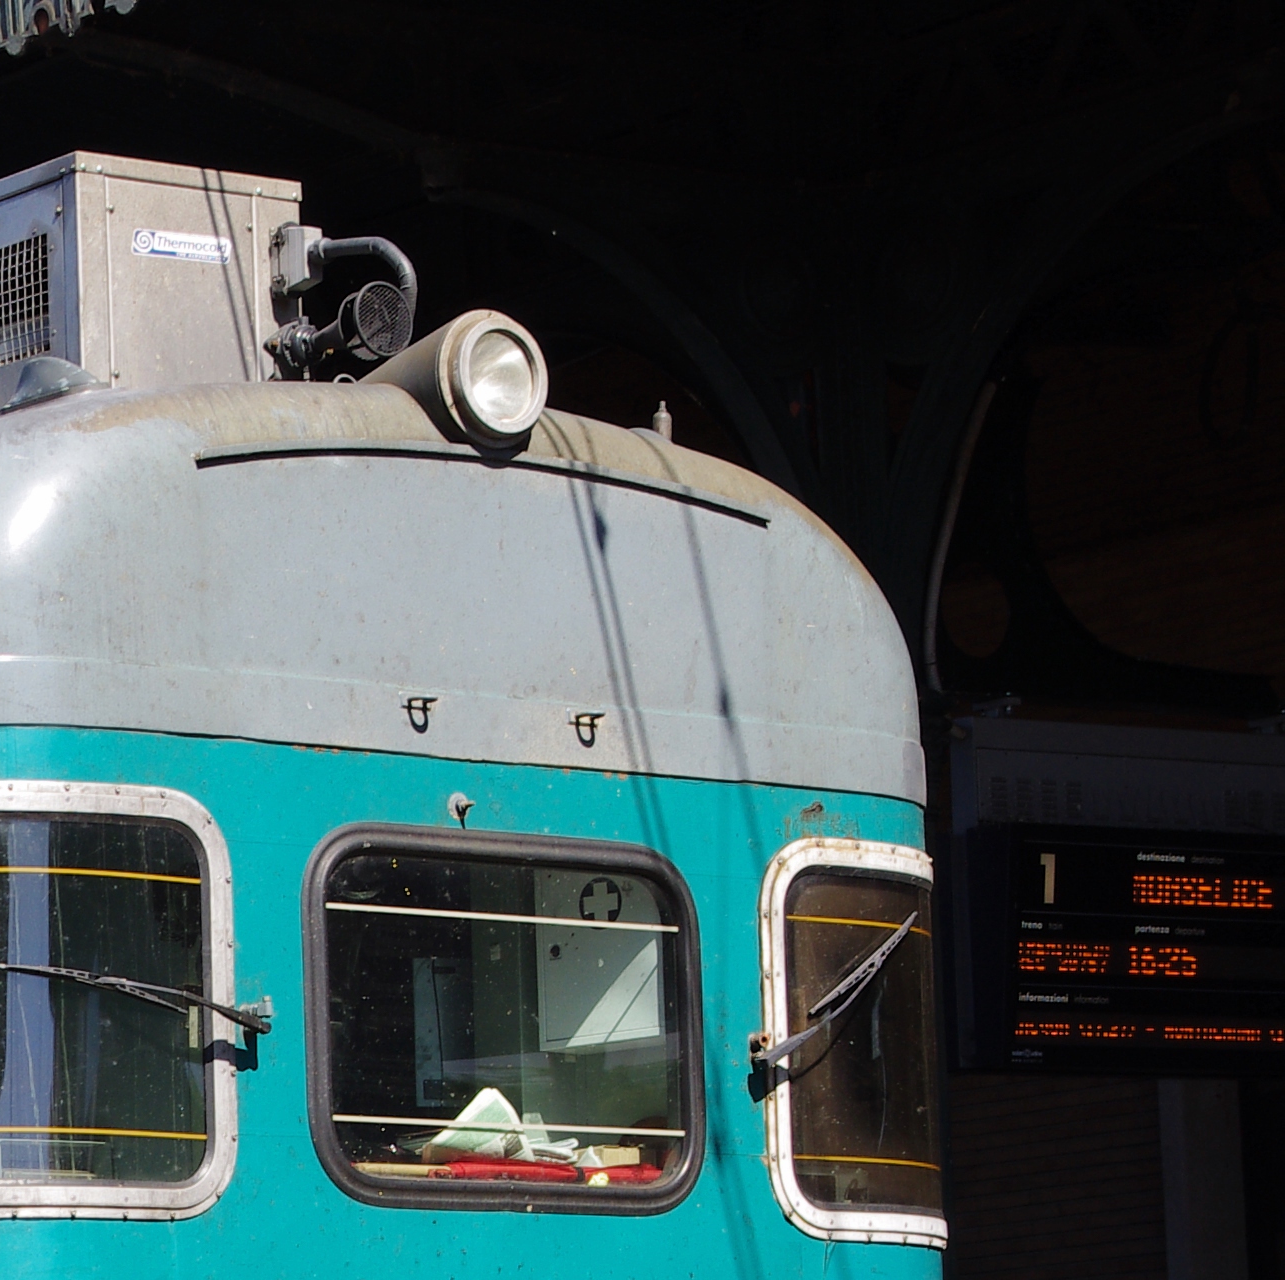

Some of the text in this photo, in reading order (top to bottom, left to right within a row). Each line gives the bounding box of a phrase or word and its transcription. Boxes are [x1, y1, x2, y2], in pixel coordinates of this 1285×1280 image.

[157, 235, 228, 254] Thermocold
[1136, 851, 1186, 863] destinazione
[1040, 853, 1056, 904] 1
[1021, 920, 1043, 930] treno
[1134, 924, 1170, 936] partenza
[1018, 992, 1069, 1004] informazioni
